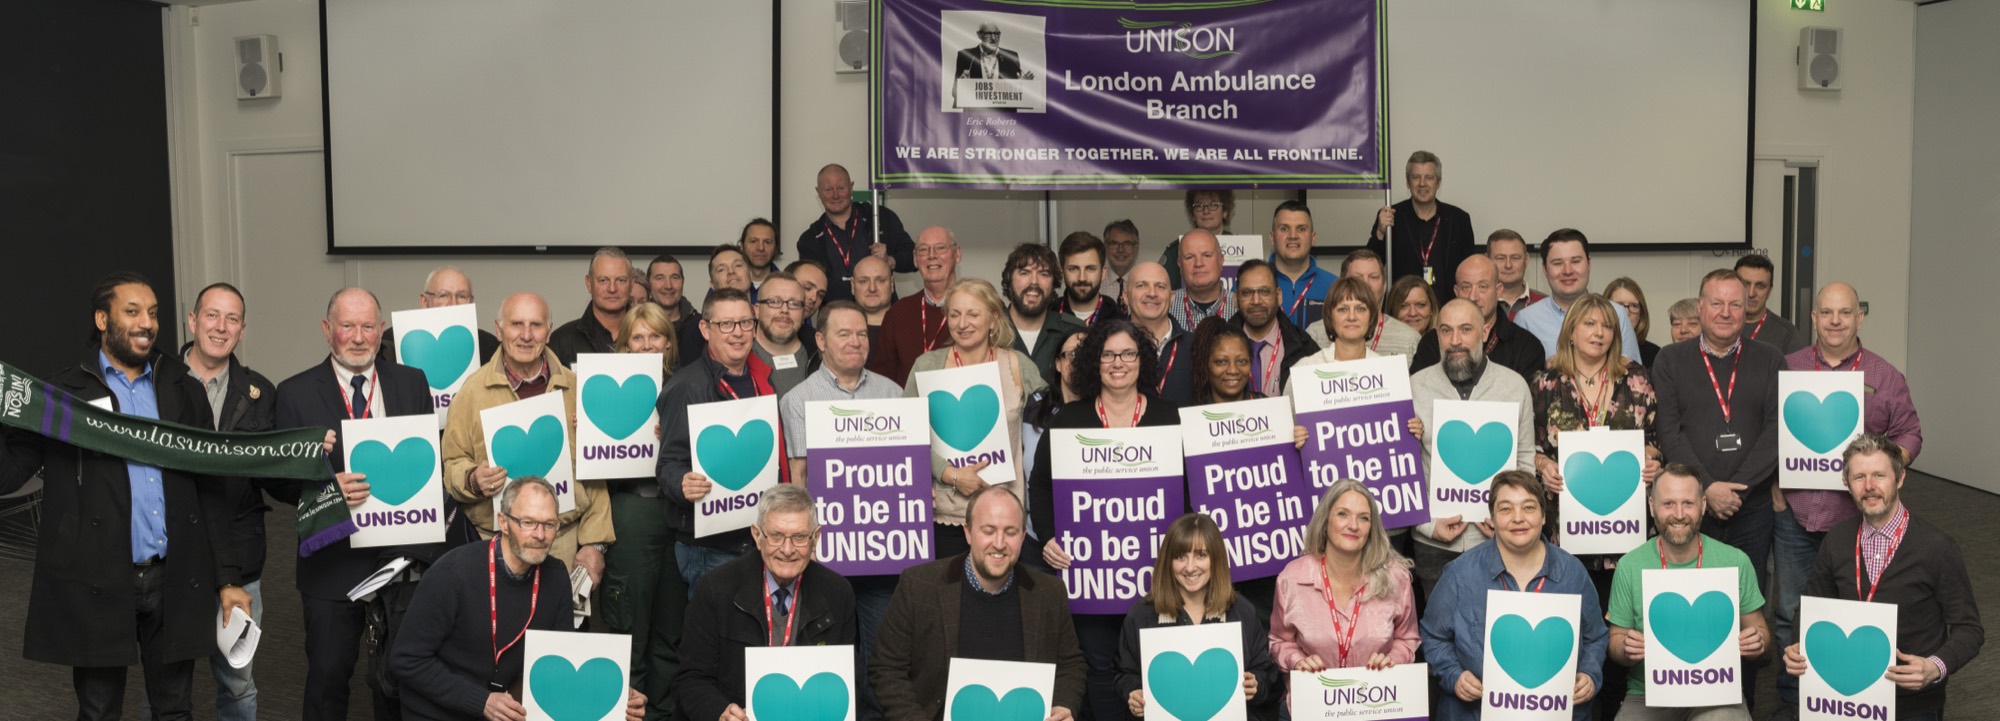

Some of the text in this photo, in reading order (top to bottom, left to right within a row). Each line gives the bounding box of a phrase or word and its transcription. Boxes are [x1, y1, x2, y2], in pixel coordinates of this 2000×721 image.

[1126, 27, 1234, 53] UNISON
[975, 82, 993, 91] JOBS
[1065, 70, 1316, 92] London Ambulance
[975, 91, 1023, 101] INVESTMENT
[1147, 99, 1238, 120] Branch
[966, 117, 1017, 127] Eric Roberts
[967, 128, 988, 137] 1949
[995, 128, 1016, 137] 2016
[896, 147, 1364, 161] WE ARE STRONGER TOGETHER. WE ARE ALL FRONTLINE.
[1321, 374, 1384, 395] UNISON
[834, 416, 901, 432] UNISON
[1208, 416, 1269, 437] UNISON
[1316, 412, 1401, 452] Proud
[86, 416, 324, 458] www.lasunison.com
[583, 443, 654, 460] UNISON
[947, 449, 1006, 469] NISON
[1081, 445, 1152, 463] UNISON
[825, 456, 913, 489] Proud
[1204, 454, 1287, 496] Proud
[1308, 448, 1417, 488] to be in
[1785, 457, 1844, 473] UNISO
[702, 490, 764, 516] UNISO
[1072, 488, 1165, 523] Proud
[1436, 487, 1491, 503] UNISO
[356, 508, 437, 528] UNISON
[815, 493, 926, 526] to be in
[1234, 498, 1271, 529] be
[1276, 491, 1303, 521] in
[1566, 519, 1640, 536] UNISON
[815, 529, 930, 563] UNISON
[1061, 530, 1092, 562] to
[1101, 529, 1140, 562] be
[1223, 525, 1308, 569] NISON
[1062, 565, 1155, 600] UNISO
[1652, 666, 1734, 686] UNISON
[1324, 684, 1397, 706] UNISON
[1489, 691, 1568, 711] UNISON
[1806, 696, 1888, 721] UNISON
